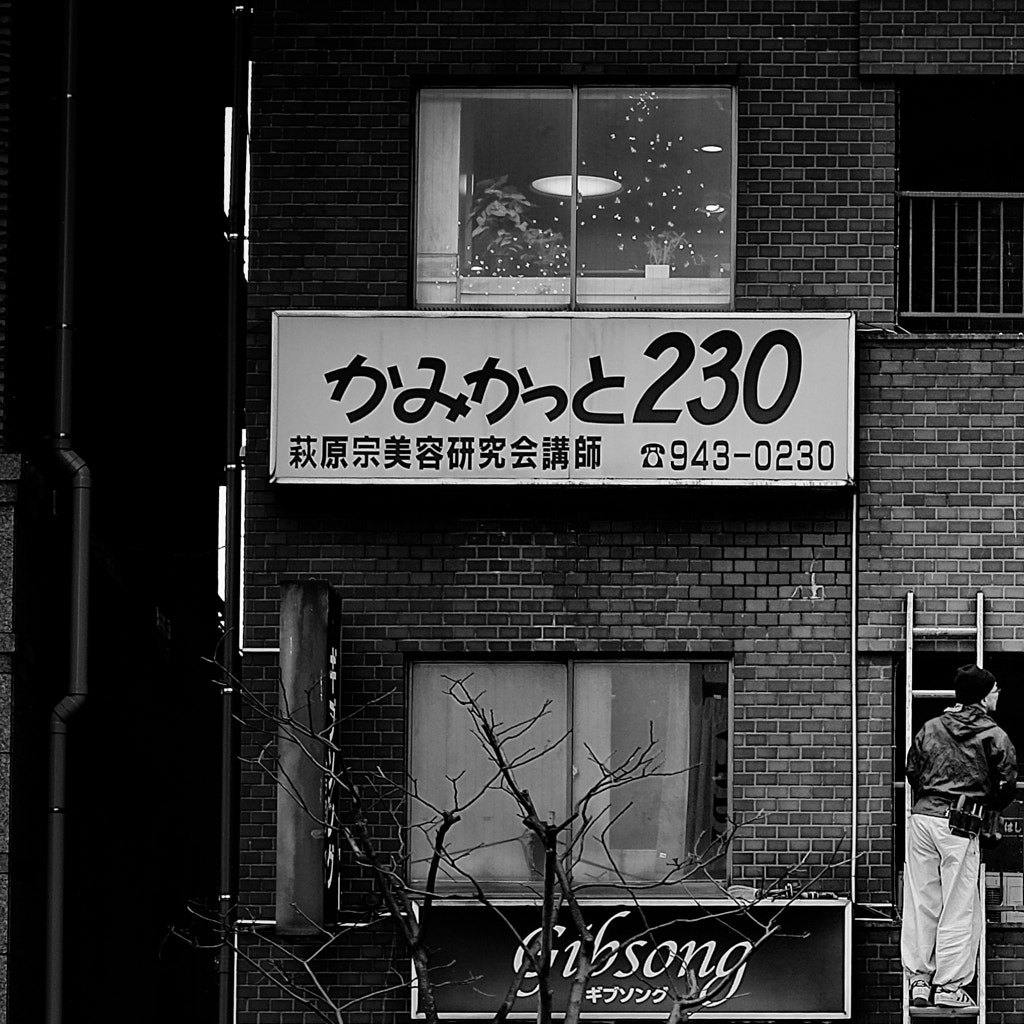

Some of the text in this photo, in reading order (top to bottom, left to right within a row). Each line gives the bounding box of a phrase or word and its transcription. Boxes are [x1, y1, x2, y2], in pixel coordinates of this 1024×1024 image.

[288, 434, 836, 471] 萩原宗美容研究会講師 943-0230
[513, 910, 757, 1008] Gibsong
[585, 986, 670, 1004] ギブソング
